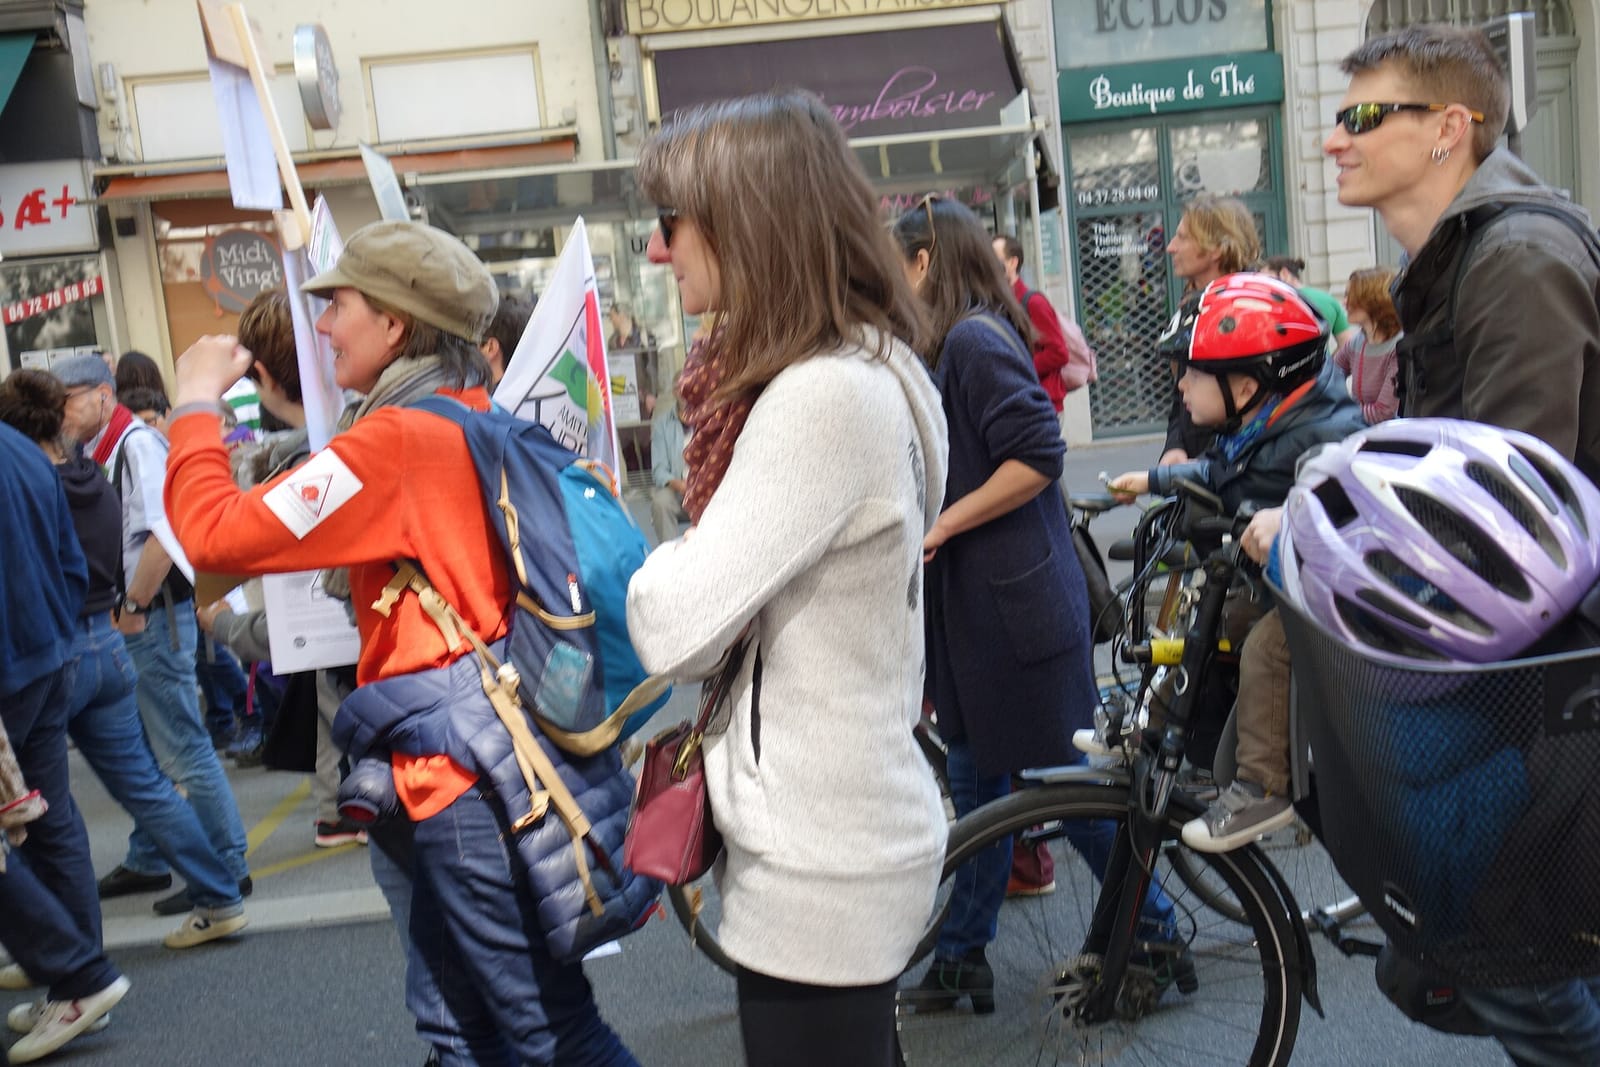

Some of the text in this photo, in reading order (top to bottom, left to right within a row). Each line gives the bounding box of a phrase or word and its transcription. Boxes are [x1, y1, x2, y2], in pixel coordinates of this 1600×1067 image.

[1089, 62, 1255, 113] Boutique de Thé
[217, 240, 272, 266] Midi
[220, 261, 281, 292] Vingt
